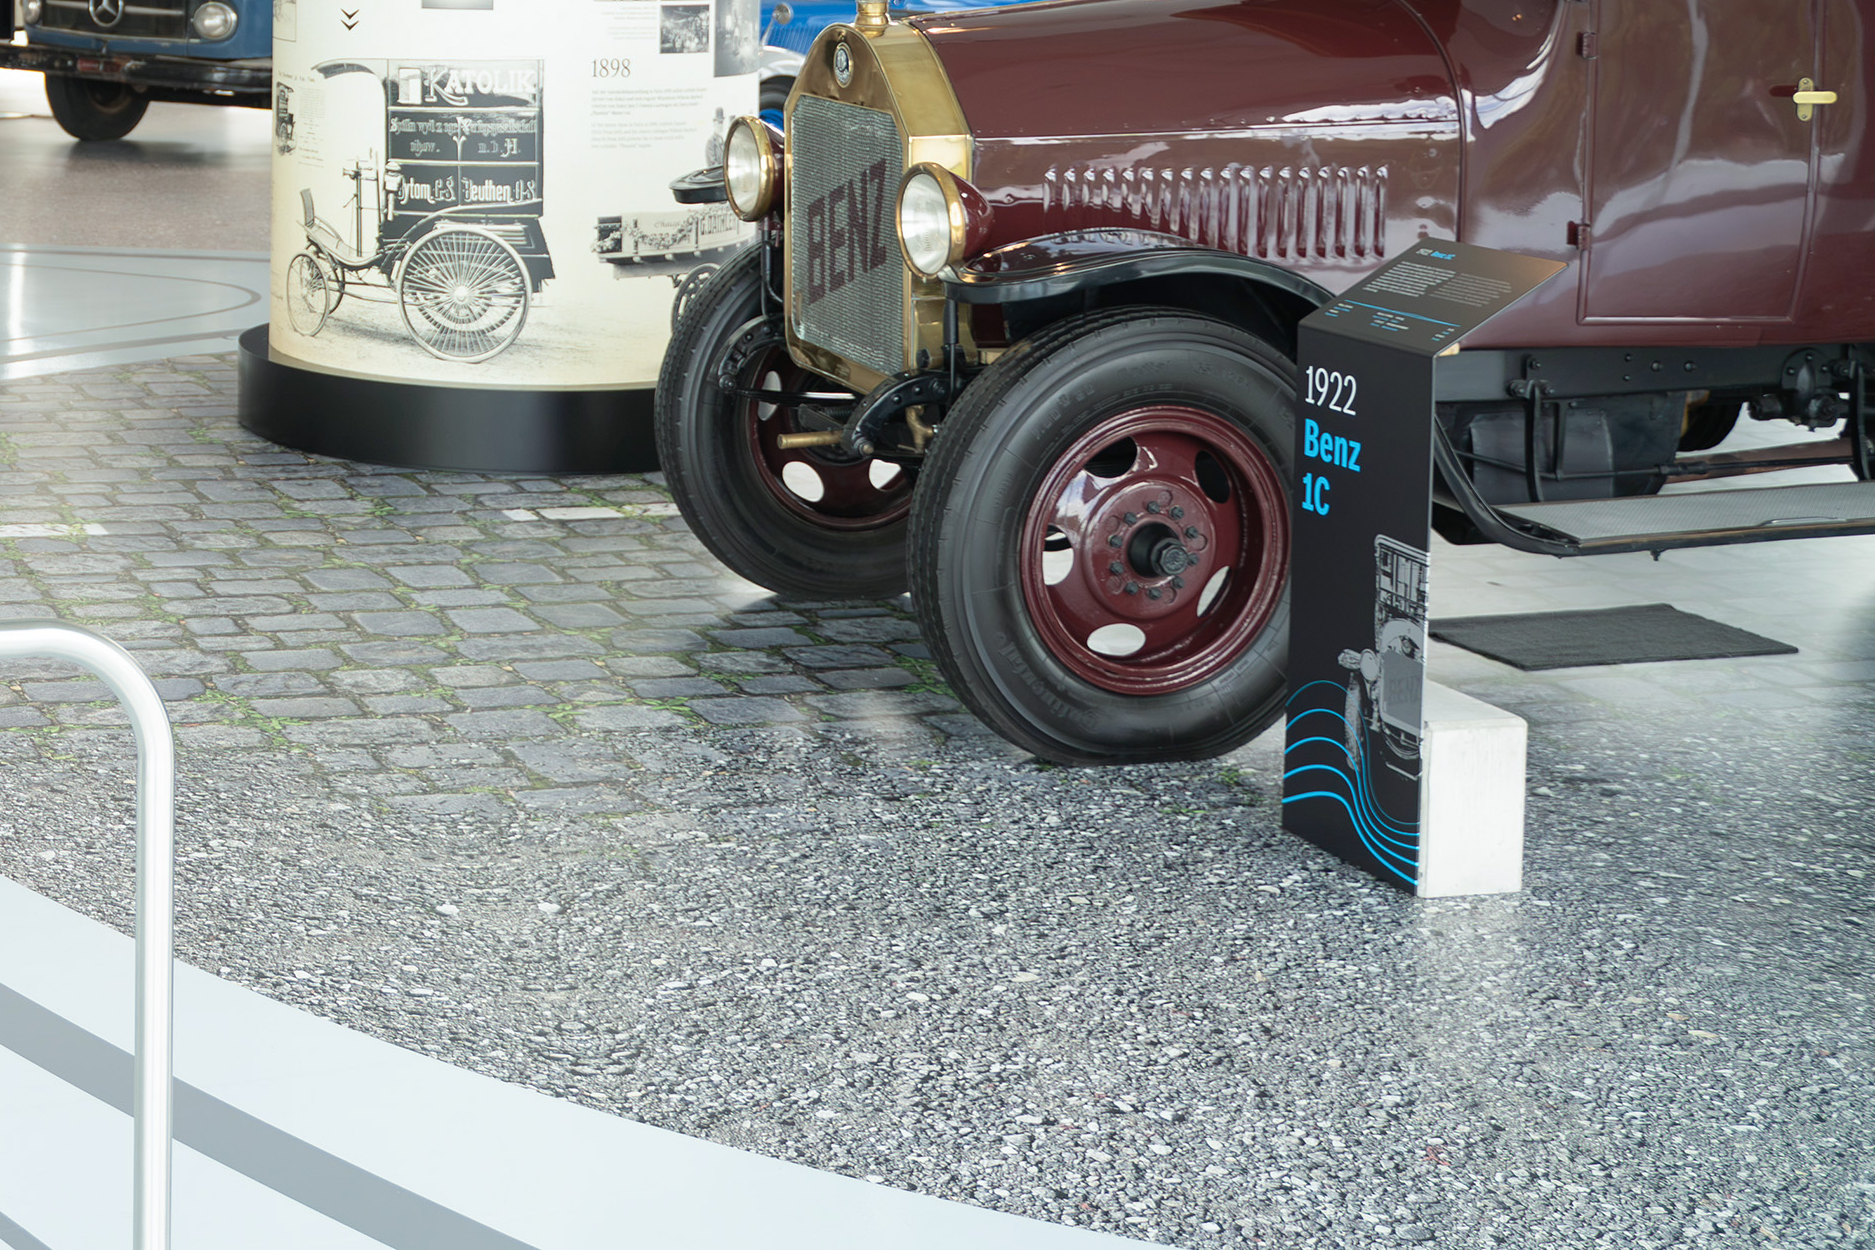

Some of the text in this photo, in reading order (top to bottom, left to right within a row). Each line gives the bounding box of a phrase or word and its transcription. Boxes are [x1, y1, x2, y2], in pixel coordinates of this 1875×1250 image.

[423, 66, 536, 106] KATOLIK
[591, 58, 631, 79] 1898
[806, 158, 887, 305] BENZ
[1305, 365, 1357, 416] 1922
[1303, 418, 1361, 472] Benz
[1301, 472, 1331, 516] 1C
